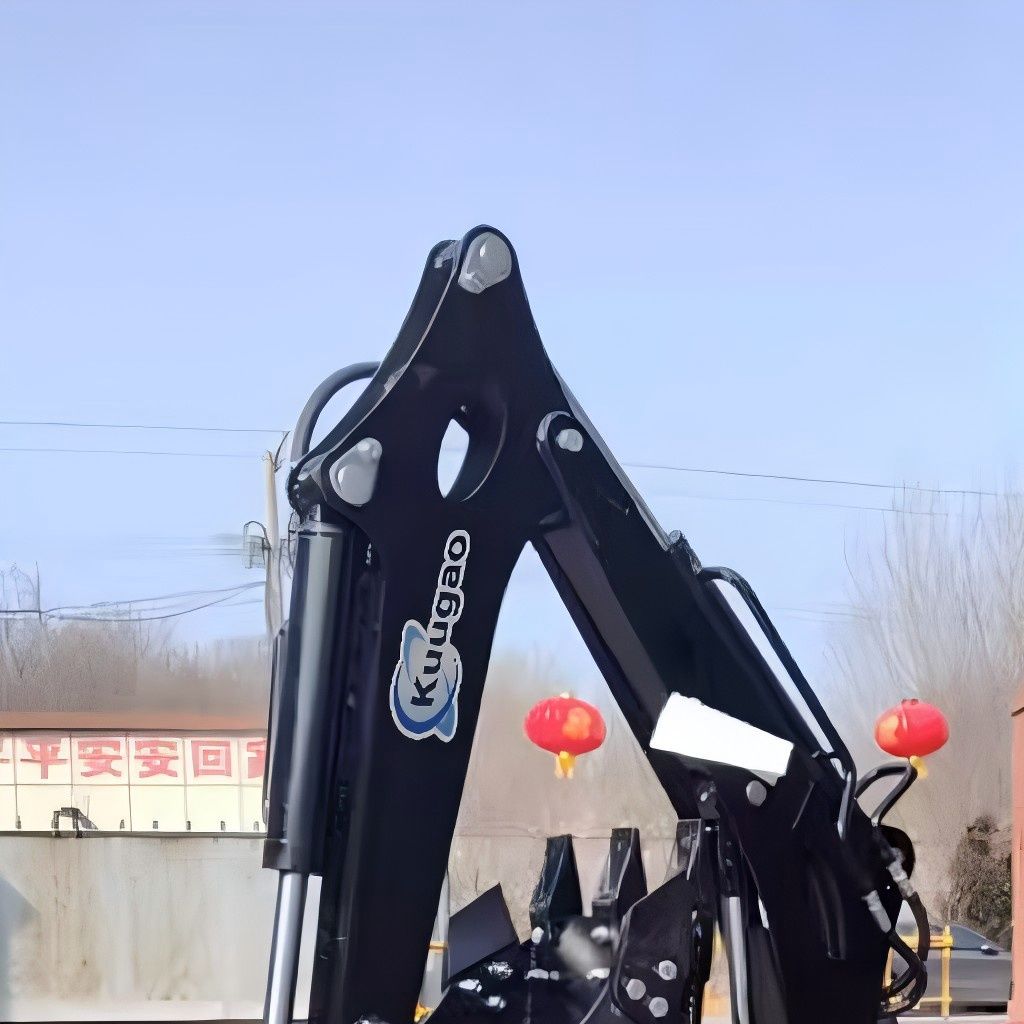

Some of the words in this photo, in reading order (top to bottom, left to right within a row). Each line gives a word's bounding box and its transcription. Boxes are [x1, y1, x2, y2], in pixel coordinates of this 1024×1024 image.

[410, 534, 468, 707] Kuugao
[0, 737, 266, 780] 平安安回
